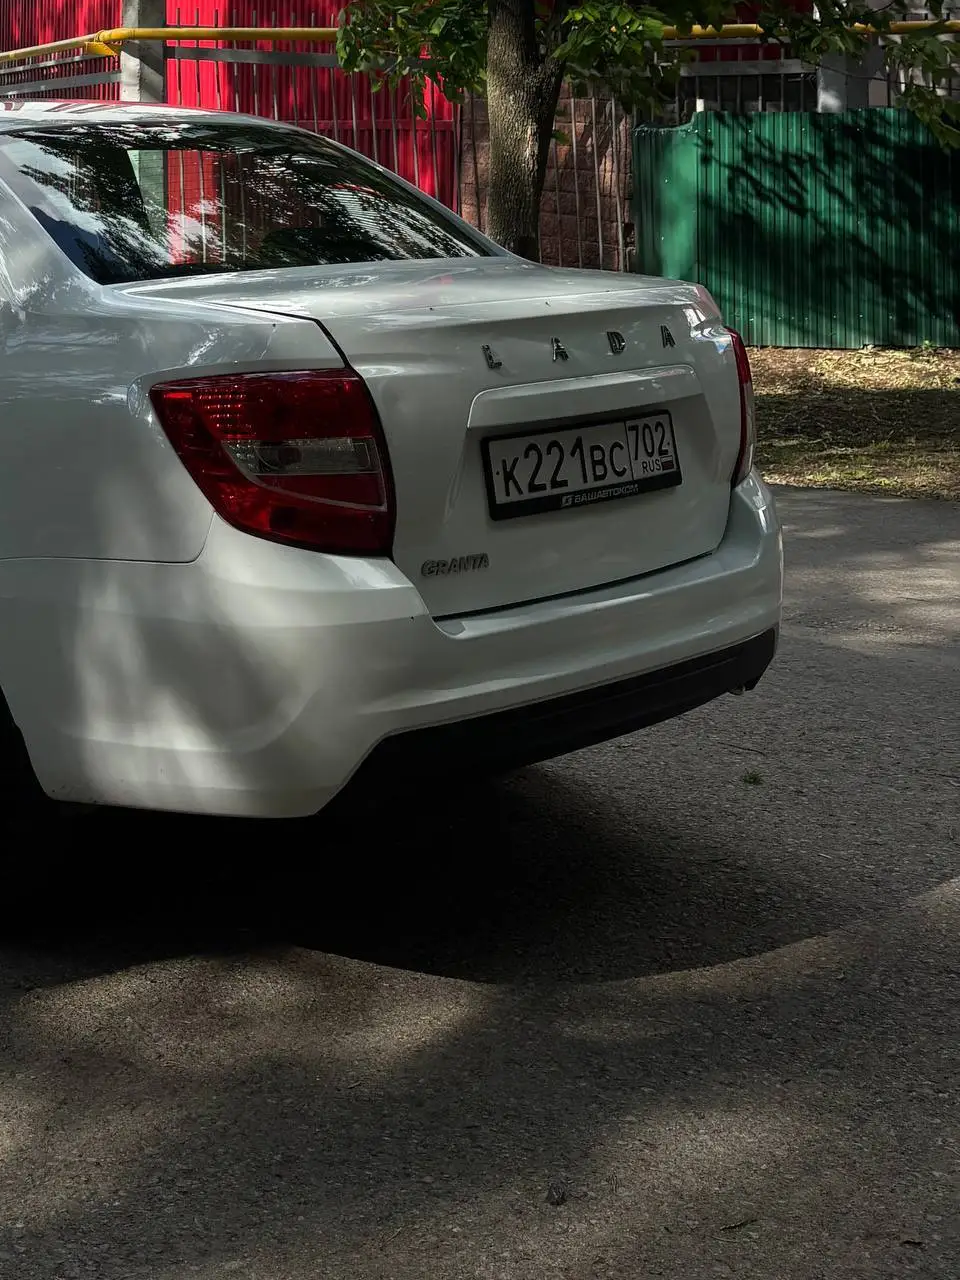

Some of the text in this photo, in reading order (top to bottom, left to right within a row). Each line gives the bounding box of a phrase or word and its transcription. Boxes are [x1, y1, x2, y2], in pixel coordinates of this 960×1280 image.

[481, 325, 677, 369] LADA
[501, 421, 670, 497] К221ВС 702
[642, 458, 661, 474] RUS
[421, 553, 489, 577] GRANTA
